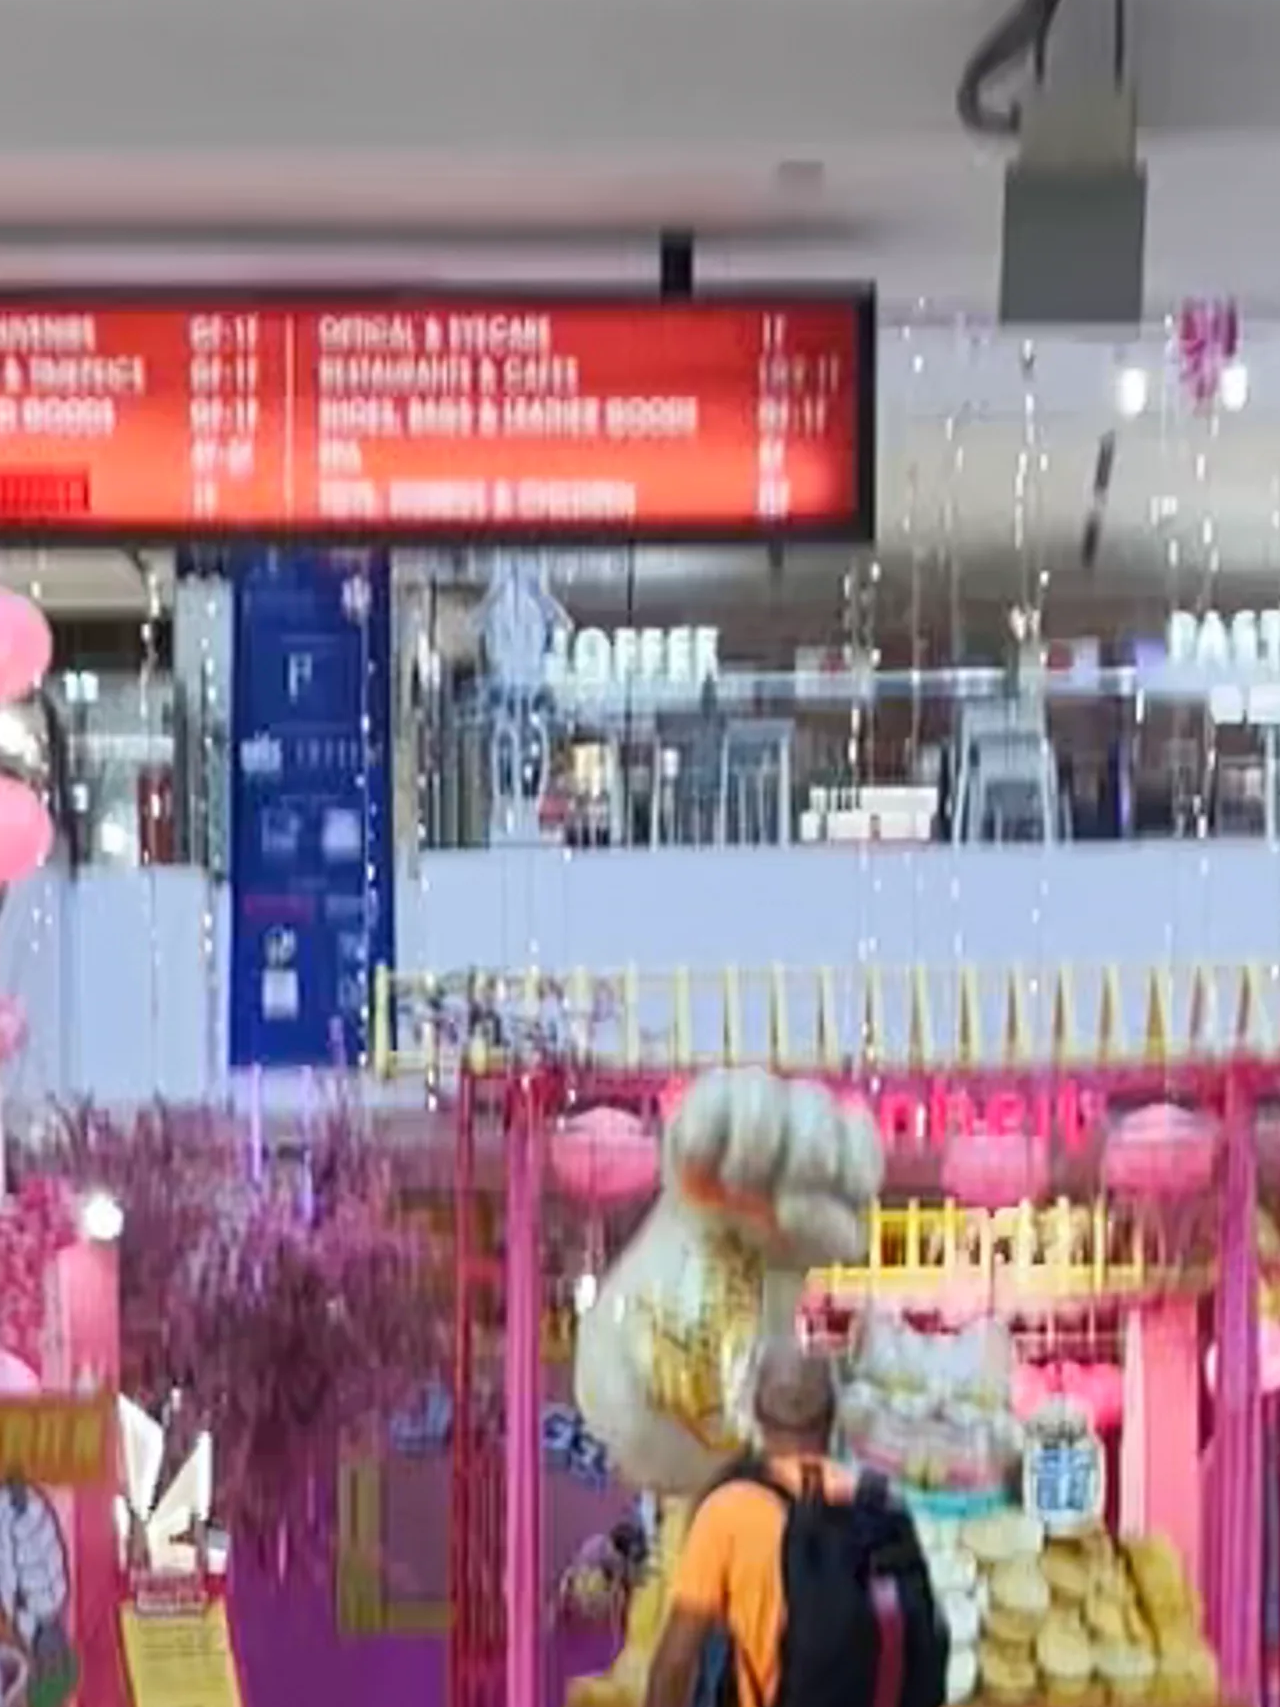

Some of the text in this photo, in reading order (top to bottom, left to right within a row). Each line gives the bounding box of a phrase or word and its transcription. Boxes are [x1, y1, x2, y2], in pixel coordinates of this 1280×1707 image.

[320, 313, 551, 355] OPTICAL & EYECARE
[4, 355, 25, 394] &
[319, 356, 471, 396] RESTAURANTS
[478, 356, 497, 396] &
[22, 396, 116, 436] GOODS
[480, 395, 499, 438] &
[503, 395, 600, 438] LEATHER
[605, 395, 698, 438] GOODS
